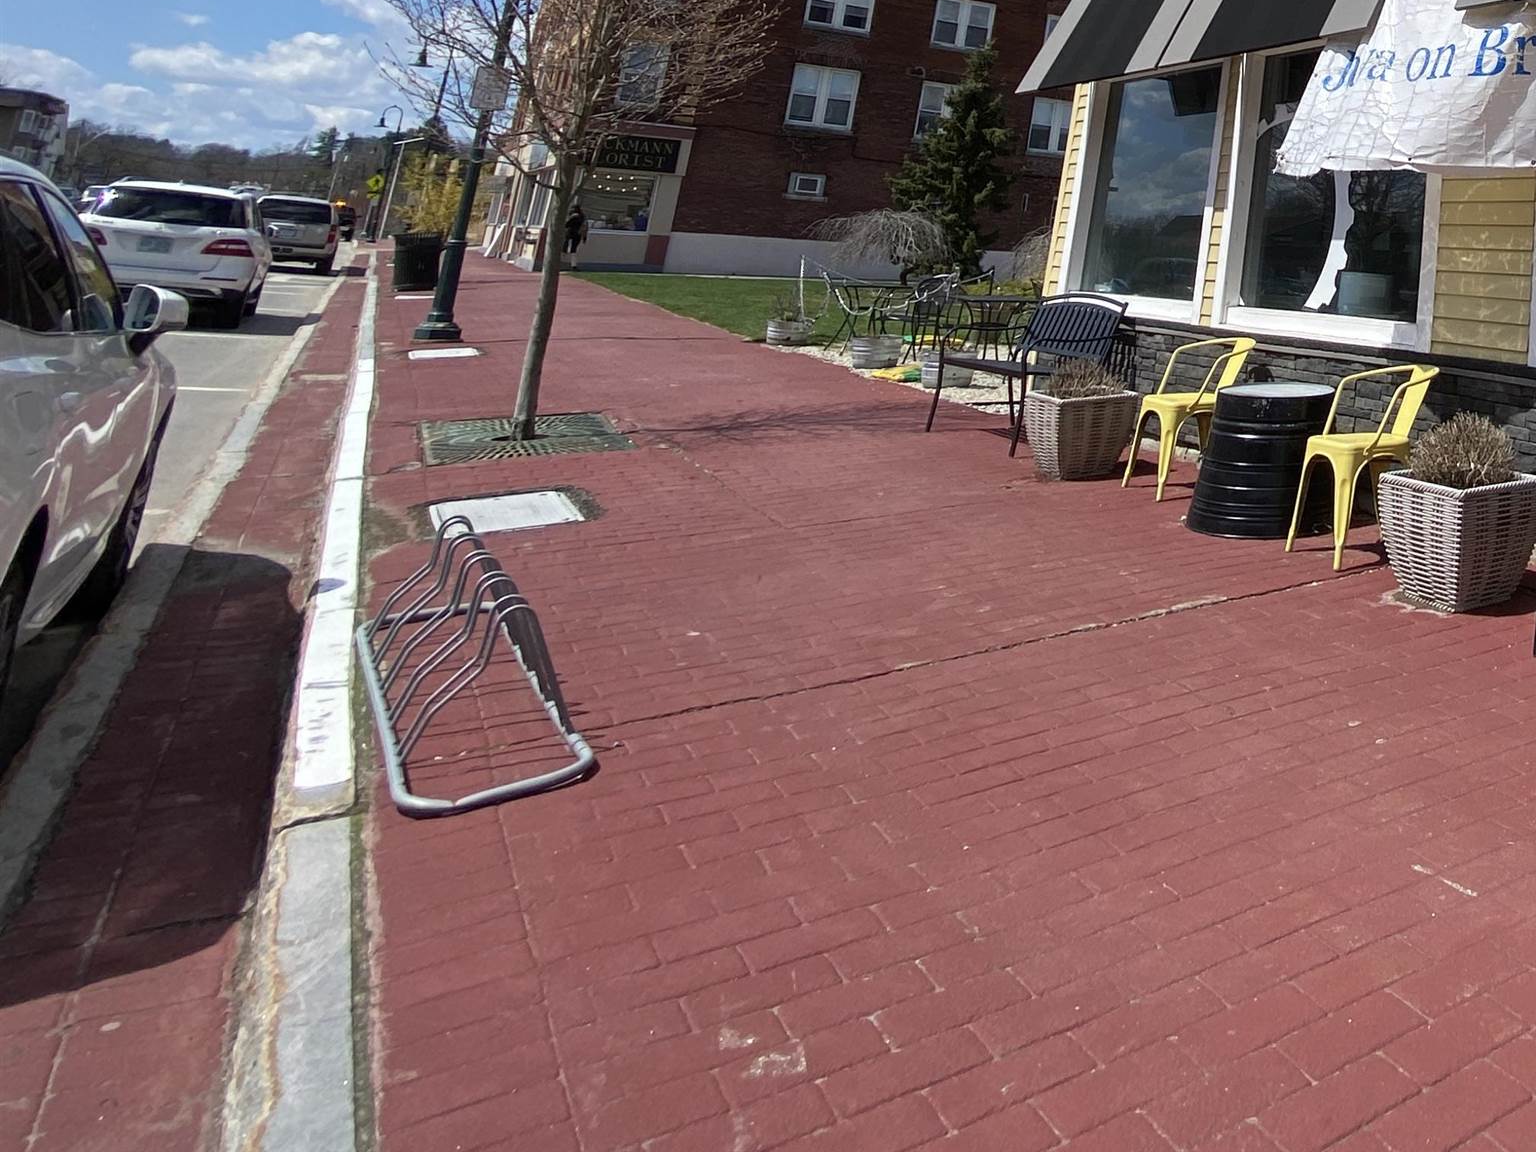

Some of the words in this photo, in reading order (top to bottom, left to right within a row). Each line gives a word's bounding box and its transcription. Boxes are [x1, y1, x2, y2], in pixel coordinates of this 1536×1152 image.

[1405, 43, 1456, 82] on
[592, 135, 674, 154] CKMANN
[595, 151, 666, 168] ORIST
